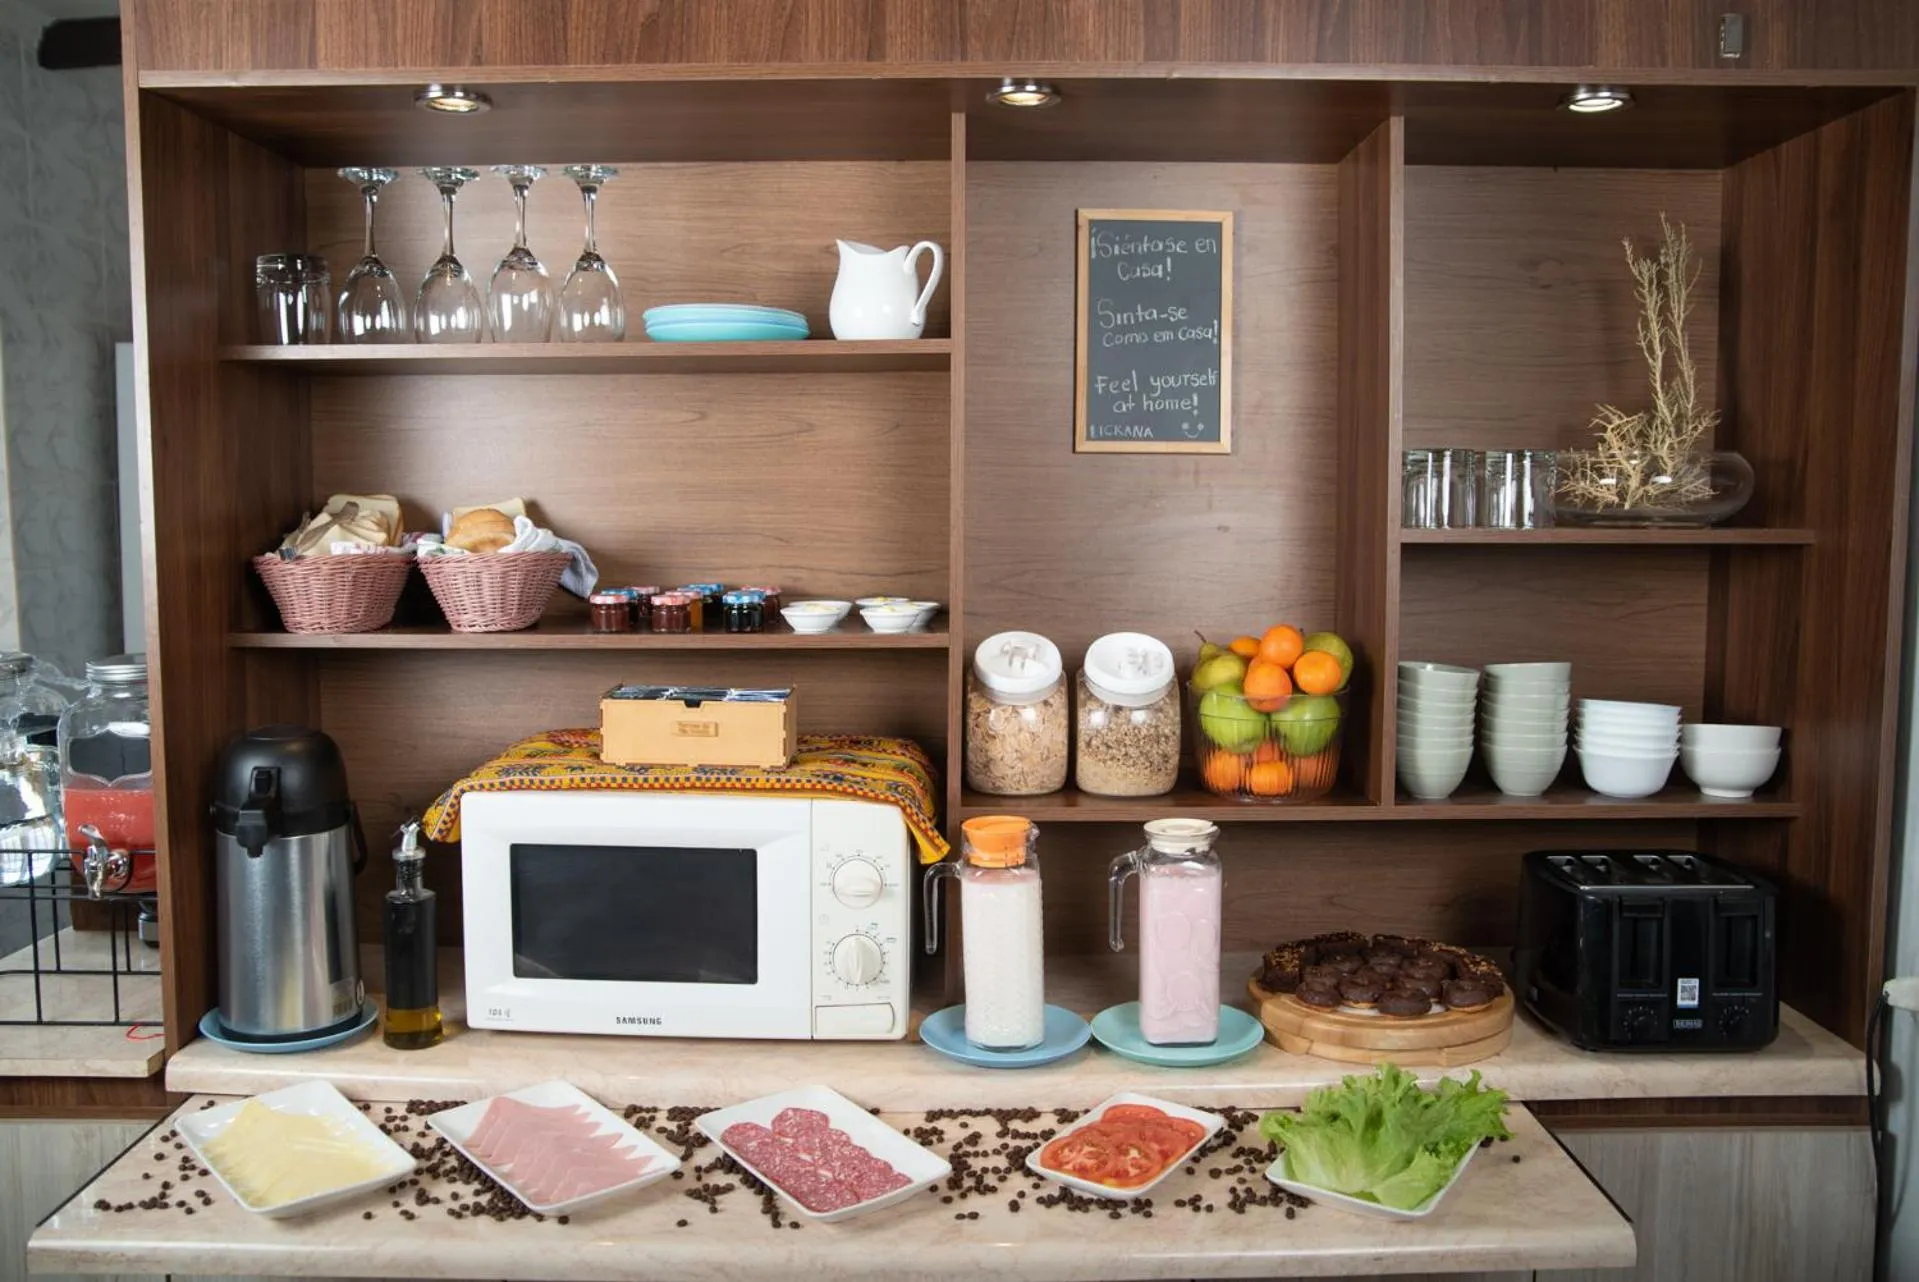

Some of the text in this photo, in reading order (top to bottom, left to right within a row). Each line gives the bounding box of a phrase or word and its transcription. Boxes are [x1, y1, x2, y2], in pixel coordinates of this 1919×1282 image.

[1195, 237, 1217, 254] en
[1097, 298, 1188, 328] Sinta-se
[1153, 330, 1174, 343] em
[1095, 368, 1218, 397] Feel yourself
[1113, 392, 1199, 416] at home!
[616, 1016, 662, 1025] SAMSUNG
